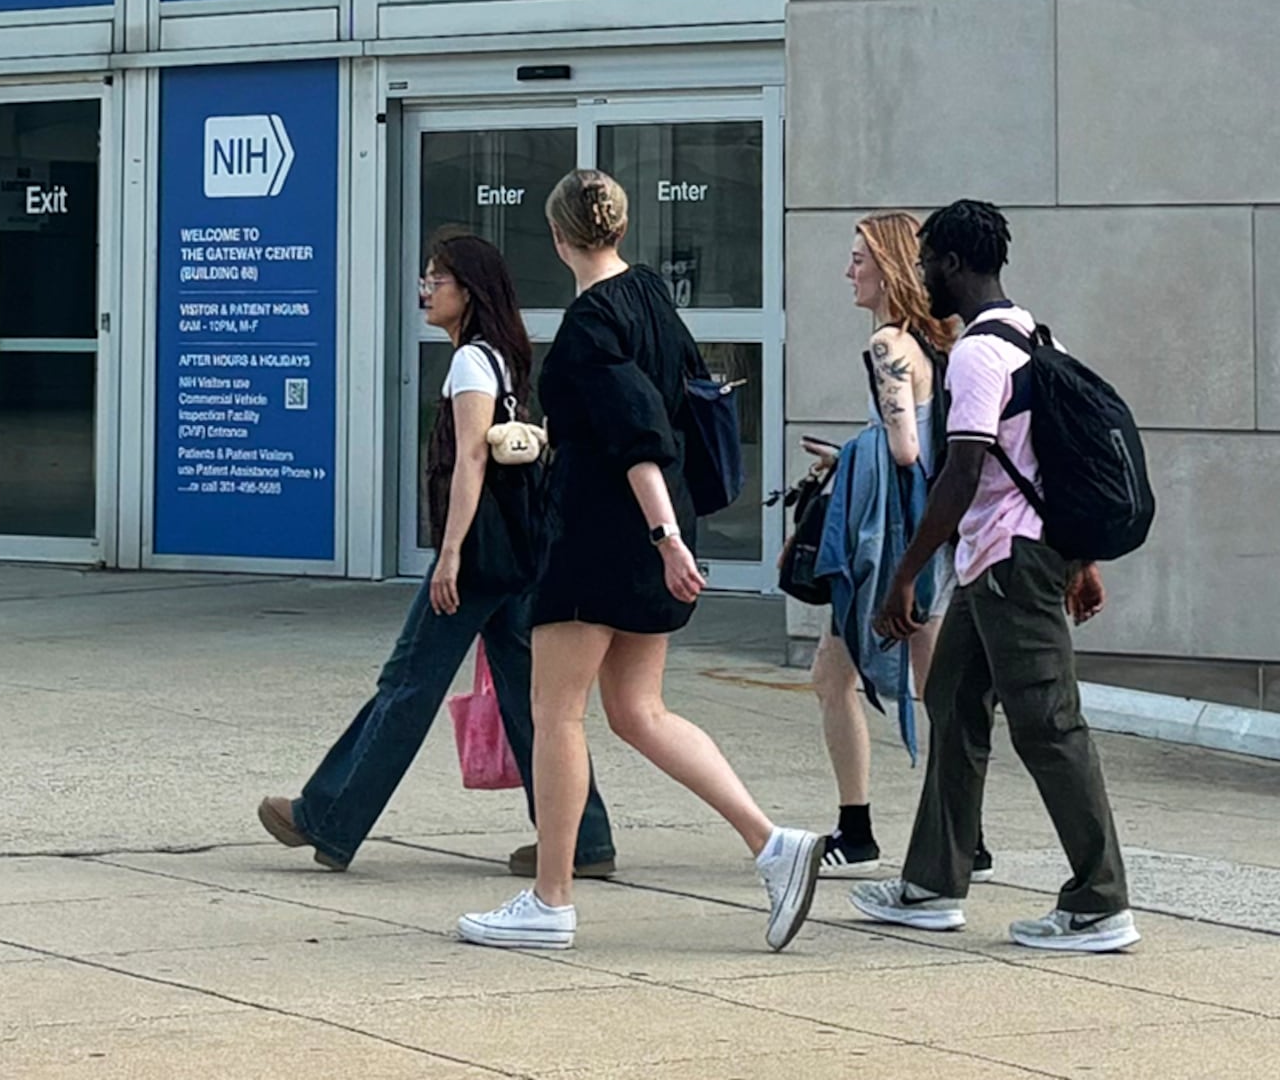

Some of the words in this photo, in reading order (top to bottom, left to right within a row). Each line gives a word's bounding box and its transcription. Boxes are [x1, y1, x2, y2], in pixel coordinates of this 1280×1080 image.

[212, 137, 268, 176] NIH
[475, 184, 525, 206] Enter
[655, 180, 708, 202] Enter
[25, 185, 69, 214] Exit
[181, 228, 240, 243] WELCOME
[243, 228, 259, 242] TO
[181, 247, 204, 262] THE
[206, 247, 262, 261] GATEWAY
[265, 246, 312, 261] CENTER
[180, 266, 239, 283] (BUILDING
[180, 304, 218, 316] VISITOR
[220, 304, 227, 316] &
[230, 303, 271, 316] PATIENT
[273, 303, 309, 316] HOURS
[240, 320, 258, 333] M-F
[179, 354, 211, 367] AFTER
[213, 355, 248, 367] HOURS
[250, 355, 257, 367] &
[259, 355, 310, 368] HOLIDAYS
[179, 377, 196, 388] NIH
[198, 377, 231, 389] Visitors
[179, 393, 232, 405] Commercial
[235, 394, 267, 406] Vehicle
[179, 410, 225, 422] Inspection
[227, 410, 259, 425] Facility
[207, 426, 247, 438] Entrance
[178, 447, 215, 460] Patients
[217, 448, 224, 460] &
[225, 448, 257, 461] Patient
[259, 449, 293, 462] Visitors
[196, 464, 228, 476] Patient
[230, 465, 279, 478] Assistance
[281, 466, 311, 479] Phone
